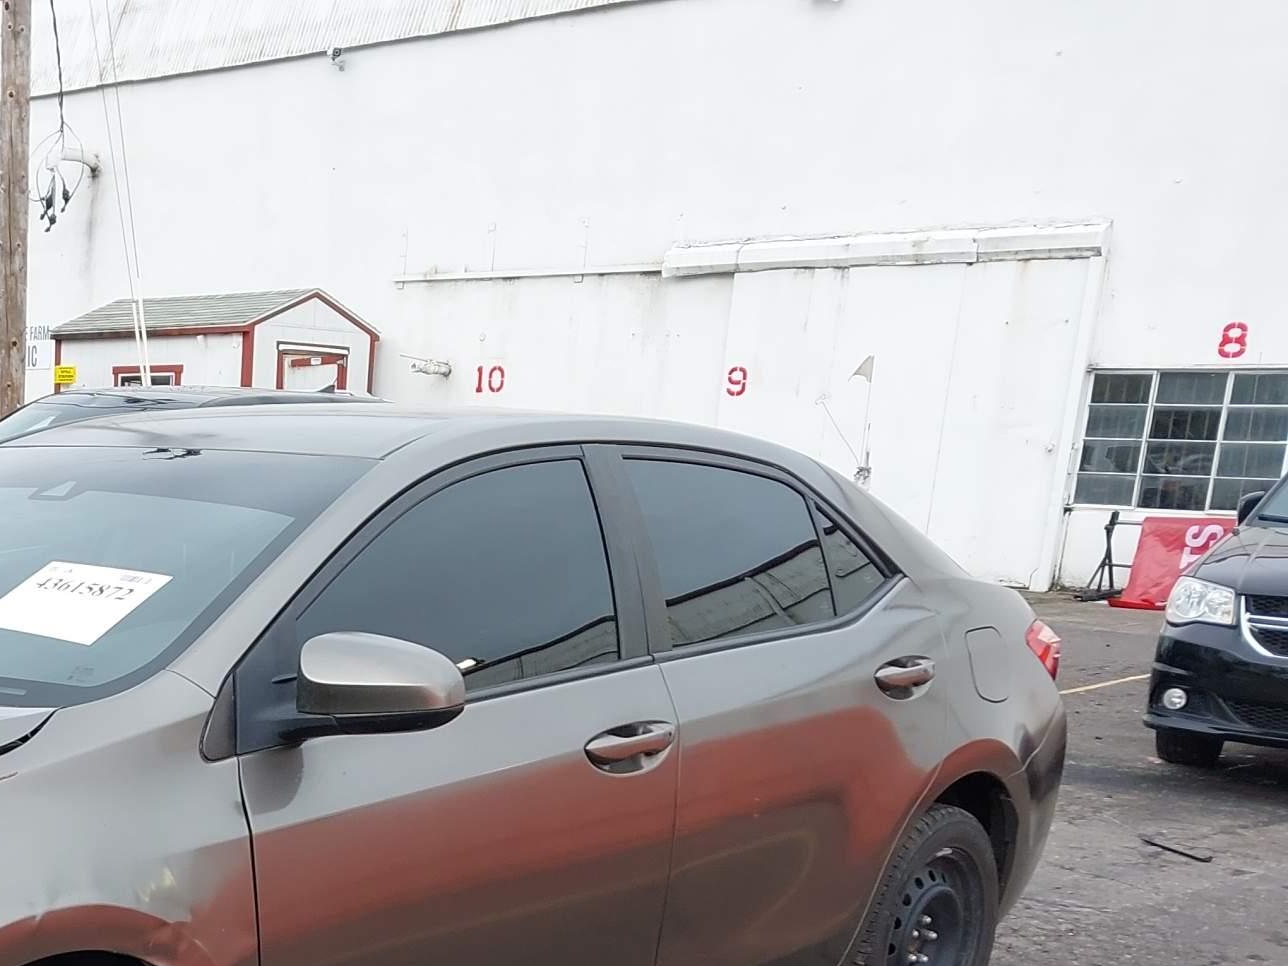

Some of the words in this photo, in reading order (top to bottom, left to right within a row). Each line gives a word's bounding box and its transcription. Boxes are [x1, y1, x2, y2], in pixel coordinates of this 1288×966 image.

[1218, 322, 1248, 358] 8
[27, 345, 38, 368] IC
[476, 366, 504, 393] 10
[727, 367, 747, 396] 9
[36, 577, 134, 600] 43615872
